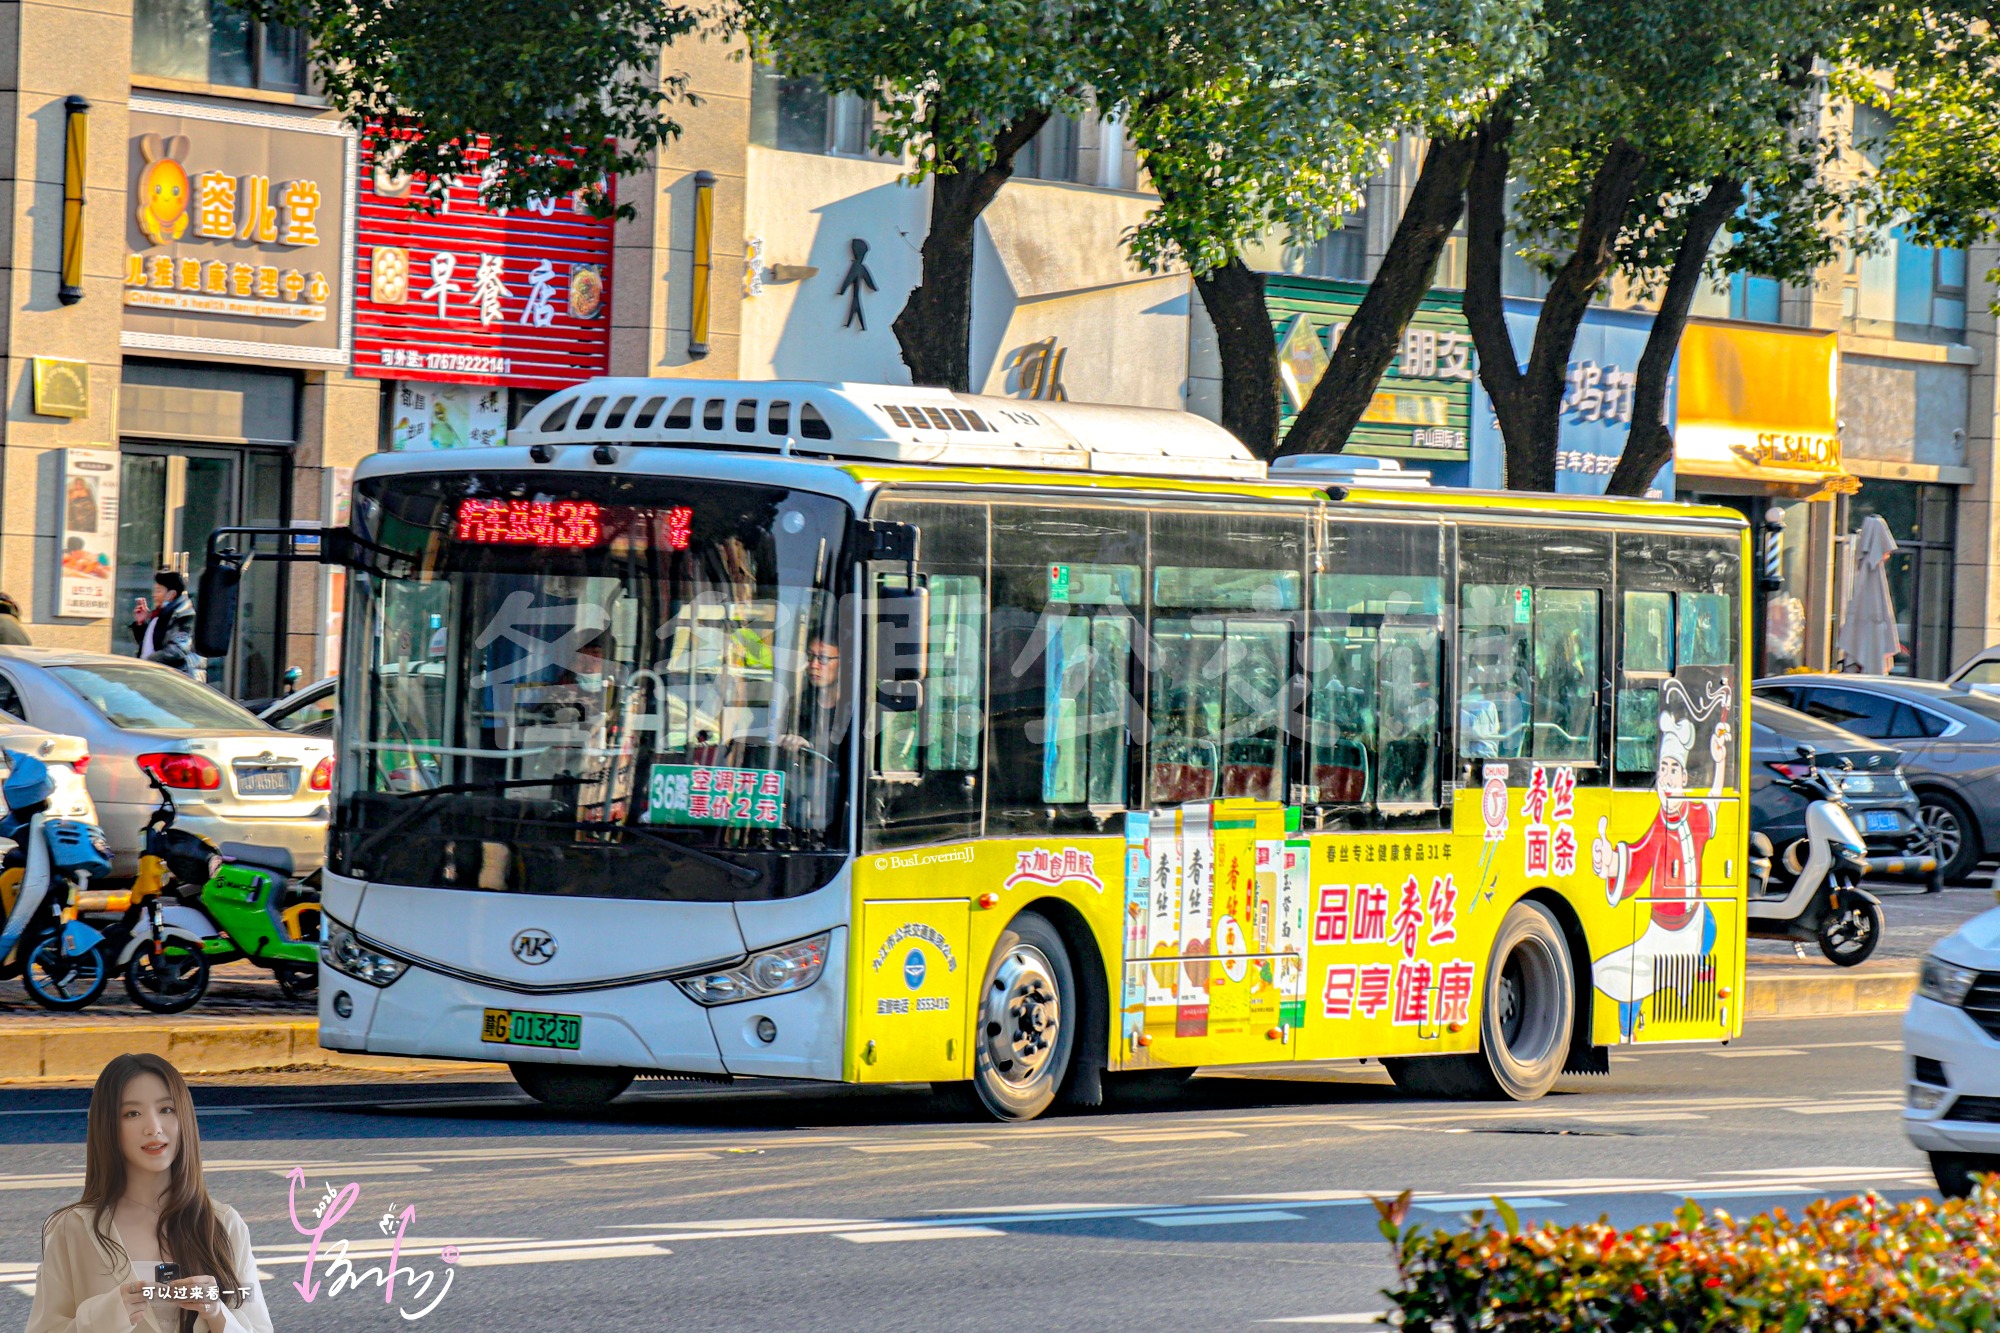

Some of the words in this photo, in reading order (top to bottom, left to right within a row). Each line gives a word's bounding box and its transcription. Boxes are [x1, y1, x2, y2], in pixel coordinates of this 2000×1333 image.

[421, 251, 557, 328] 早餐店
[652, 773, 689, 811] 36路
[691, 769, 781, 797] 空调开启
[688, 795, 778, 823] 票价2元
[1522, 767, 1575, 823] 春丝
[1017, 850, 1094, 878] 不加食用胶
[1527, 828, 1575, 872] 面条
[1313, 877, 1458, 958] 品味春丝
[1324, 962, 1474, 1023] 尽享健康
